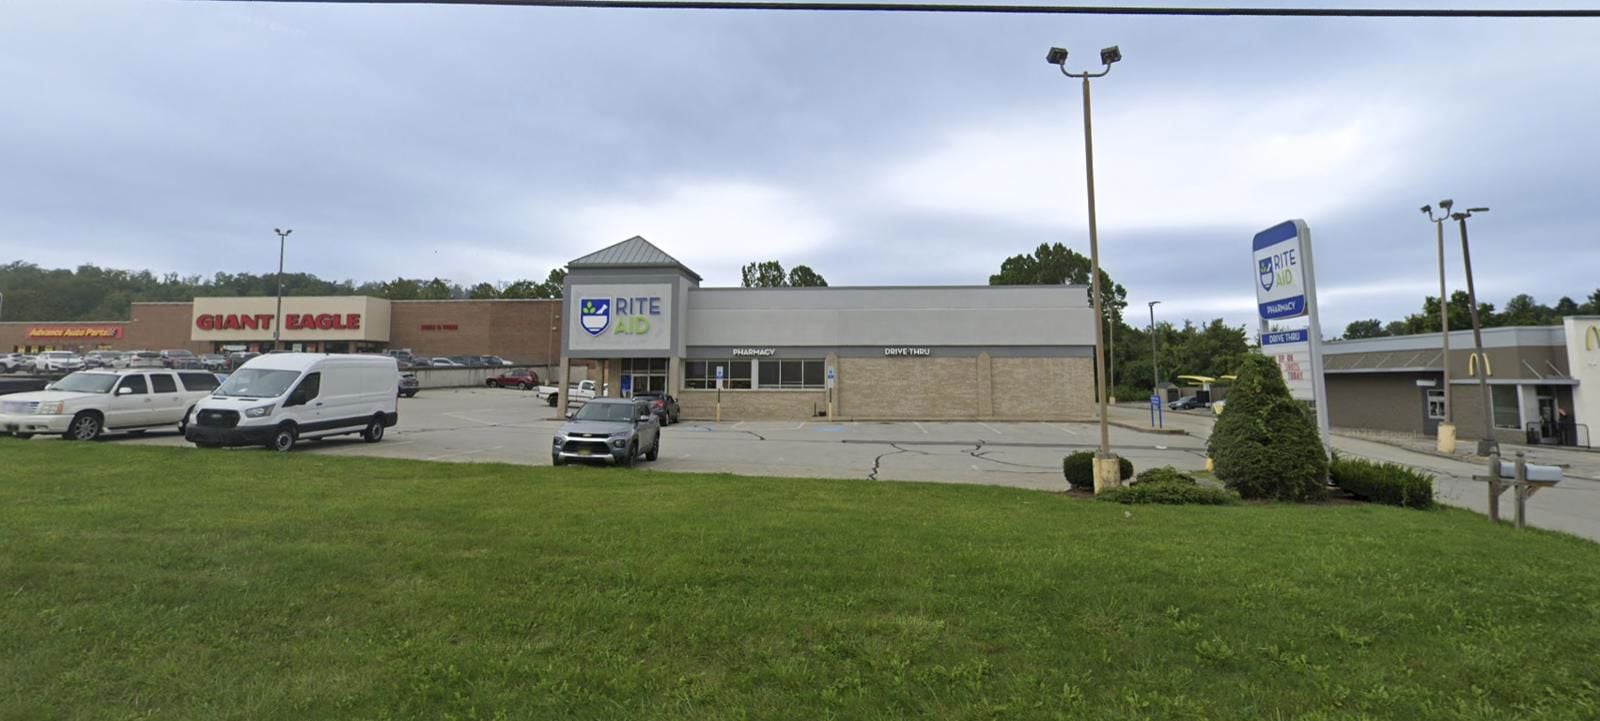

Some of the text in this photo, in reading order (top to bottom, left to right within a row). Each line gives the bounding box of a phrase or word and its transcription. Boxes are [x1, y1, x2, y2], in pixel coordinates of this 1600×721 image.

[1274, 249, 1296, 269] RITE
[1276, 269, 1294, 288] AID
[616, 297, 661, 315] RITE
[1267, 302, 1296, 314] PHARMACY
[196, 314, 361, 330] GIANT EAGLE
[613, 316, 651, 335] AID
[30, 328, 63, 337] Advance
[64, 328, 85, 337] Auto
[1269, 332, 1301, 344] DRIVE THRU
[733, 348, 776, 356] PHARMACY
[884, 347, 930, 356] DRIVE THRU
